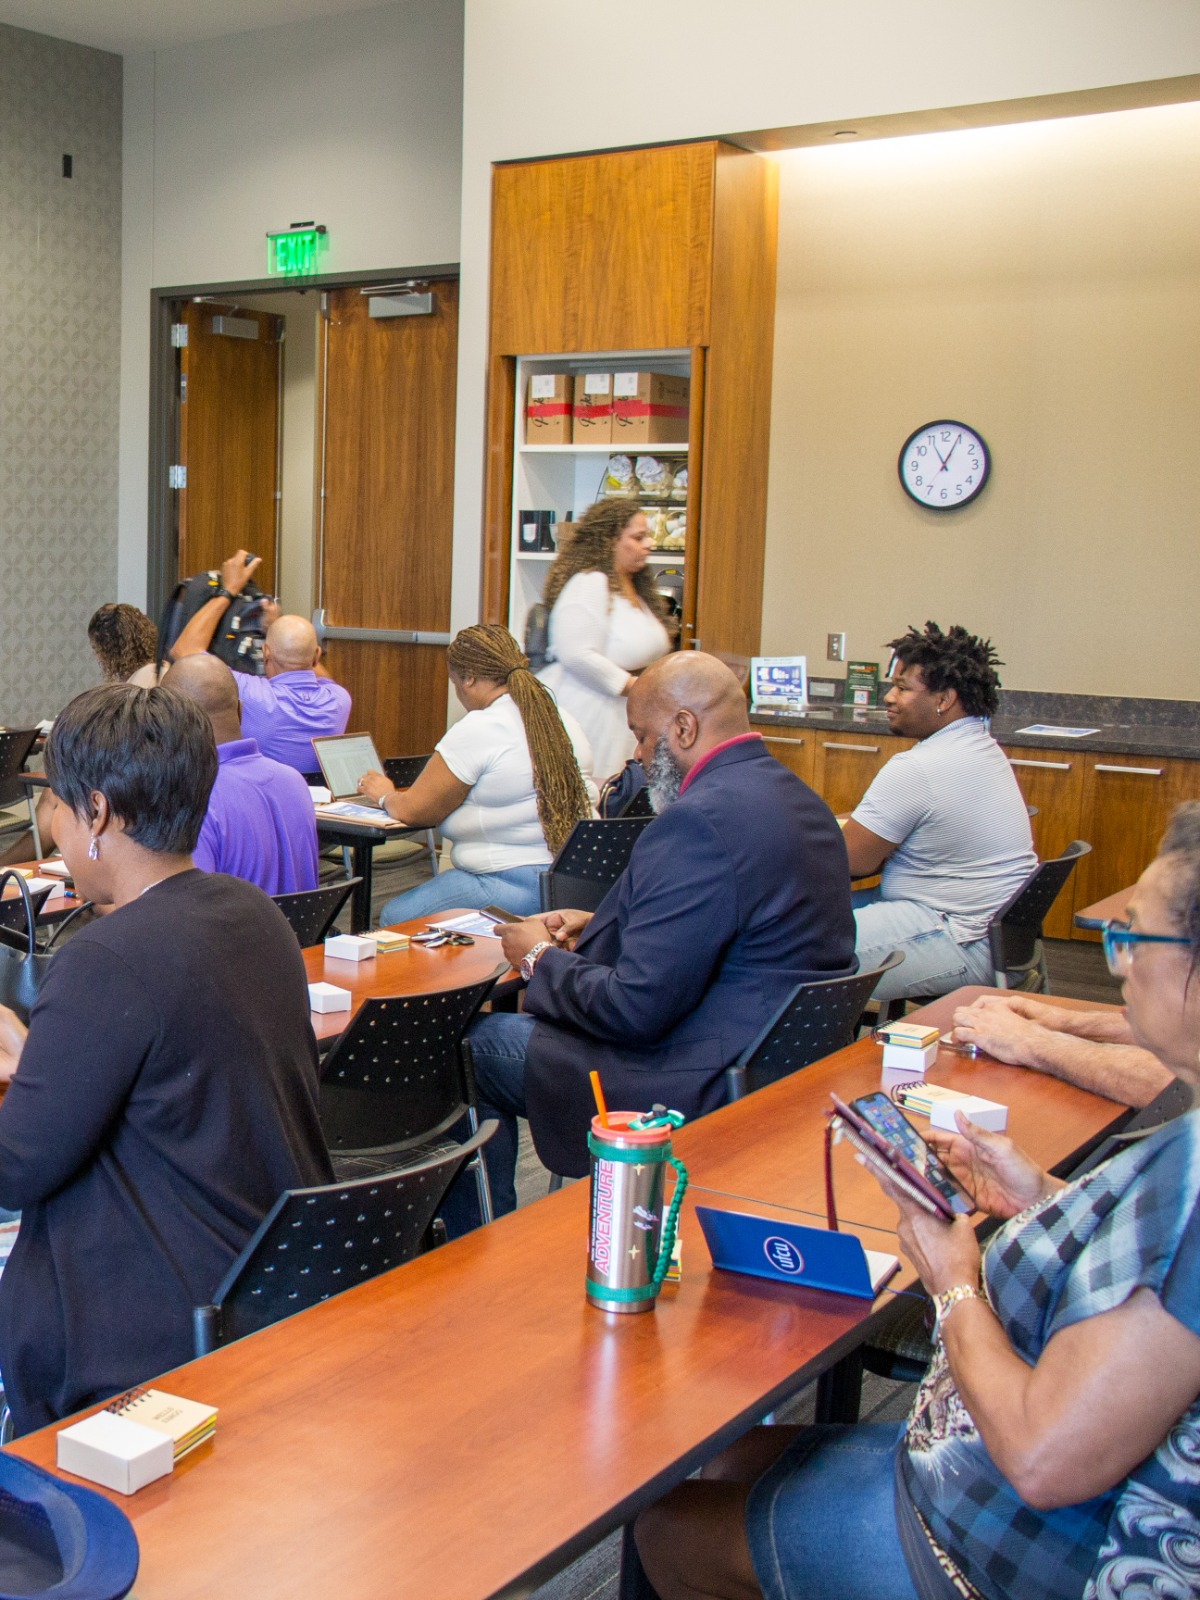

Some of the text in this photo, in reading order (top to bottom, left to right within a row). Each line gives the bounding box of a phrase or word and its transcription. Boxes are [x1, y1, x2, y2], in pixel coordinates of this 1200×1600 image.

[276, 235, 312, 271] EXIT
[927, 435, 935, 446] 11
[940, 431, 951, 442] 12
[916, 445, 927, 456] 10
[967, 443, 975, 455] 2
[911, 461, 919, 471] 9
[971, 459, 979, 470] 3
[915, 475, 923, 486] 8
[965, 475, 972, 485] 4
[926, 485, 934, 496] 7
[940, 488, 948, 500] 6
[956, 484, 963, 496] 5
[596, 1158, 614, 1275] ADVENTURE
[772, 1242, 795, 1268] ufcu
